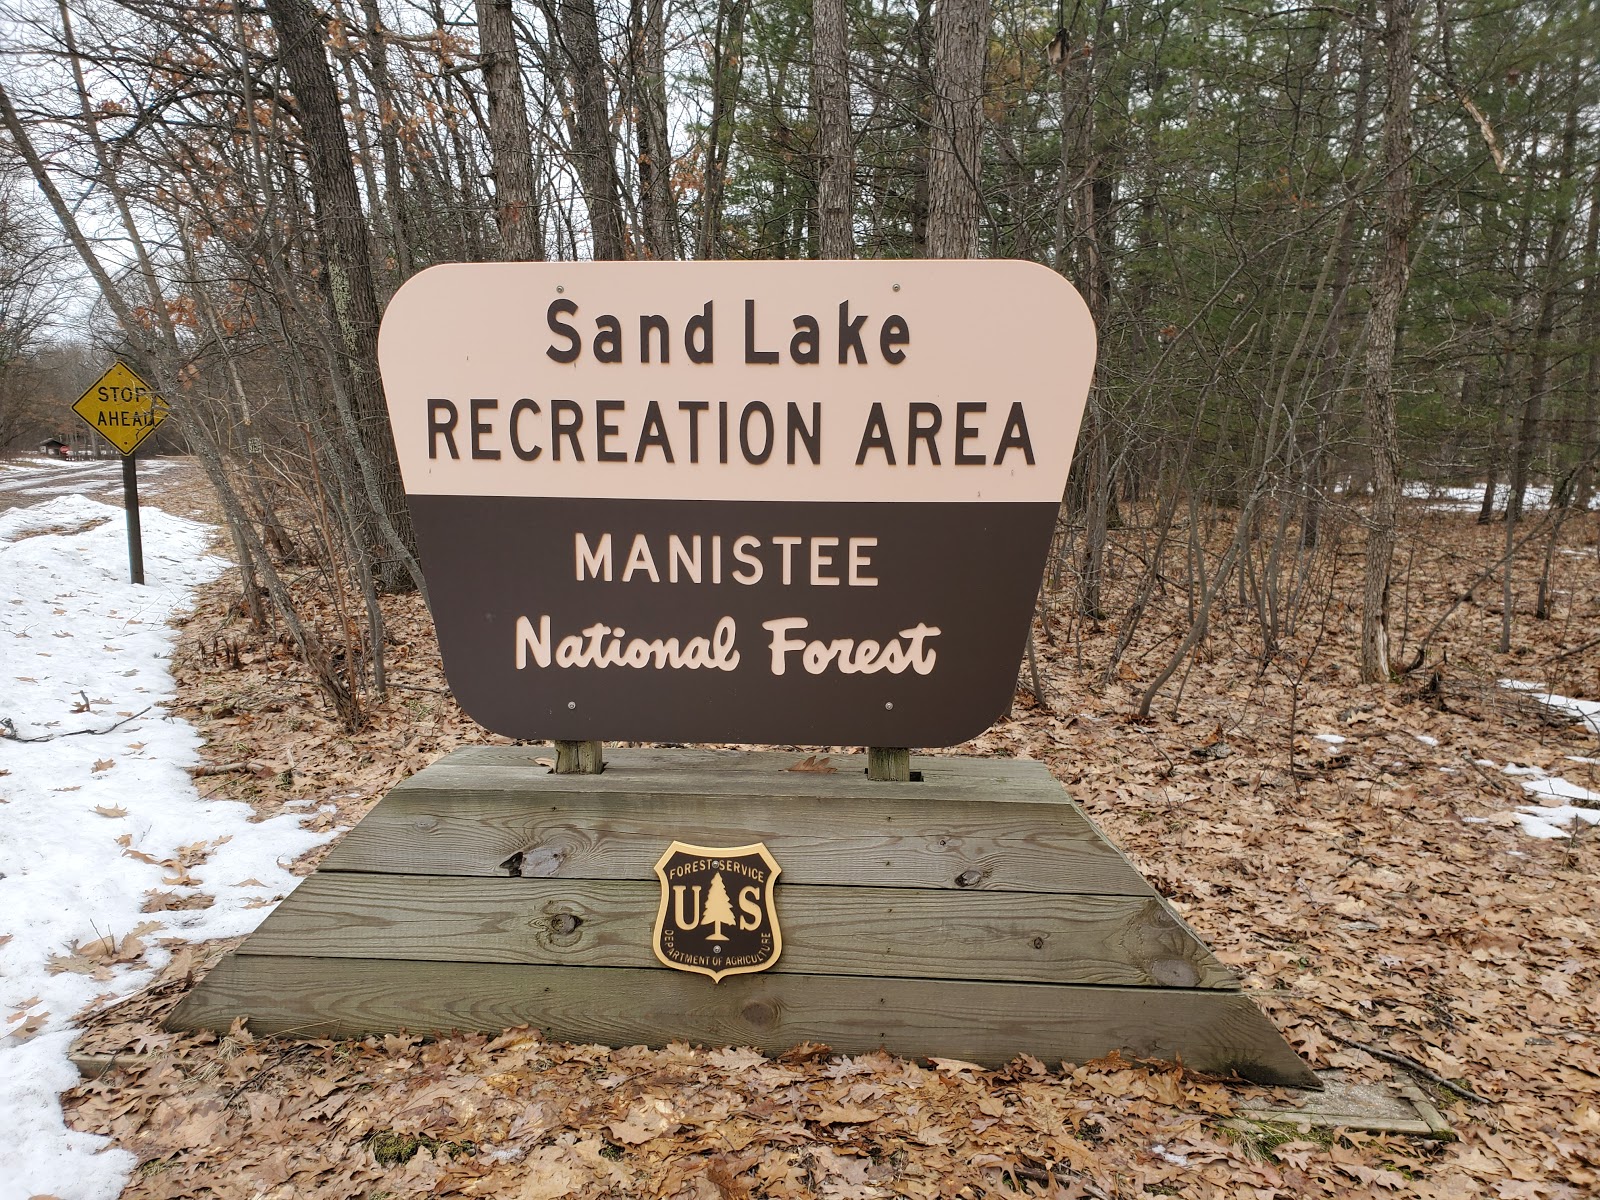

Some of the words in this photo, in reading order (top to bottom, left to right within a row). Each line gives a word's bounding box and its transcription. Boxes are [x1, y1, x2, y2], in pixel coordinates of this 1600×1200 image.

[546, 298, 714, 365] Sand
[744, 299, 910, 366] Lake
[98, 386, 146, 402] STOP
[97, 411, 154, 427] AHEAD
[427, 398, 822, 466] RECREATION
[855, 402, 1036, 467] AREA
[575, 533, 879, 587] MANISTEE
[515, 615, 741, 672] National
[762, 617, 942, 676] Forest
[669, 859, 712, 880] FOREST
[718, 859, 764, 883] SERVICE
[672, 885, 702, 931] U
[738, 885, 763, 931] S
[664, 929, 710, 966] DEPARTMENT
[712, 956, 723, 966] OF
[725, 932, 771, 966] AGRICULTURE
